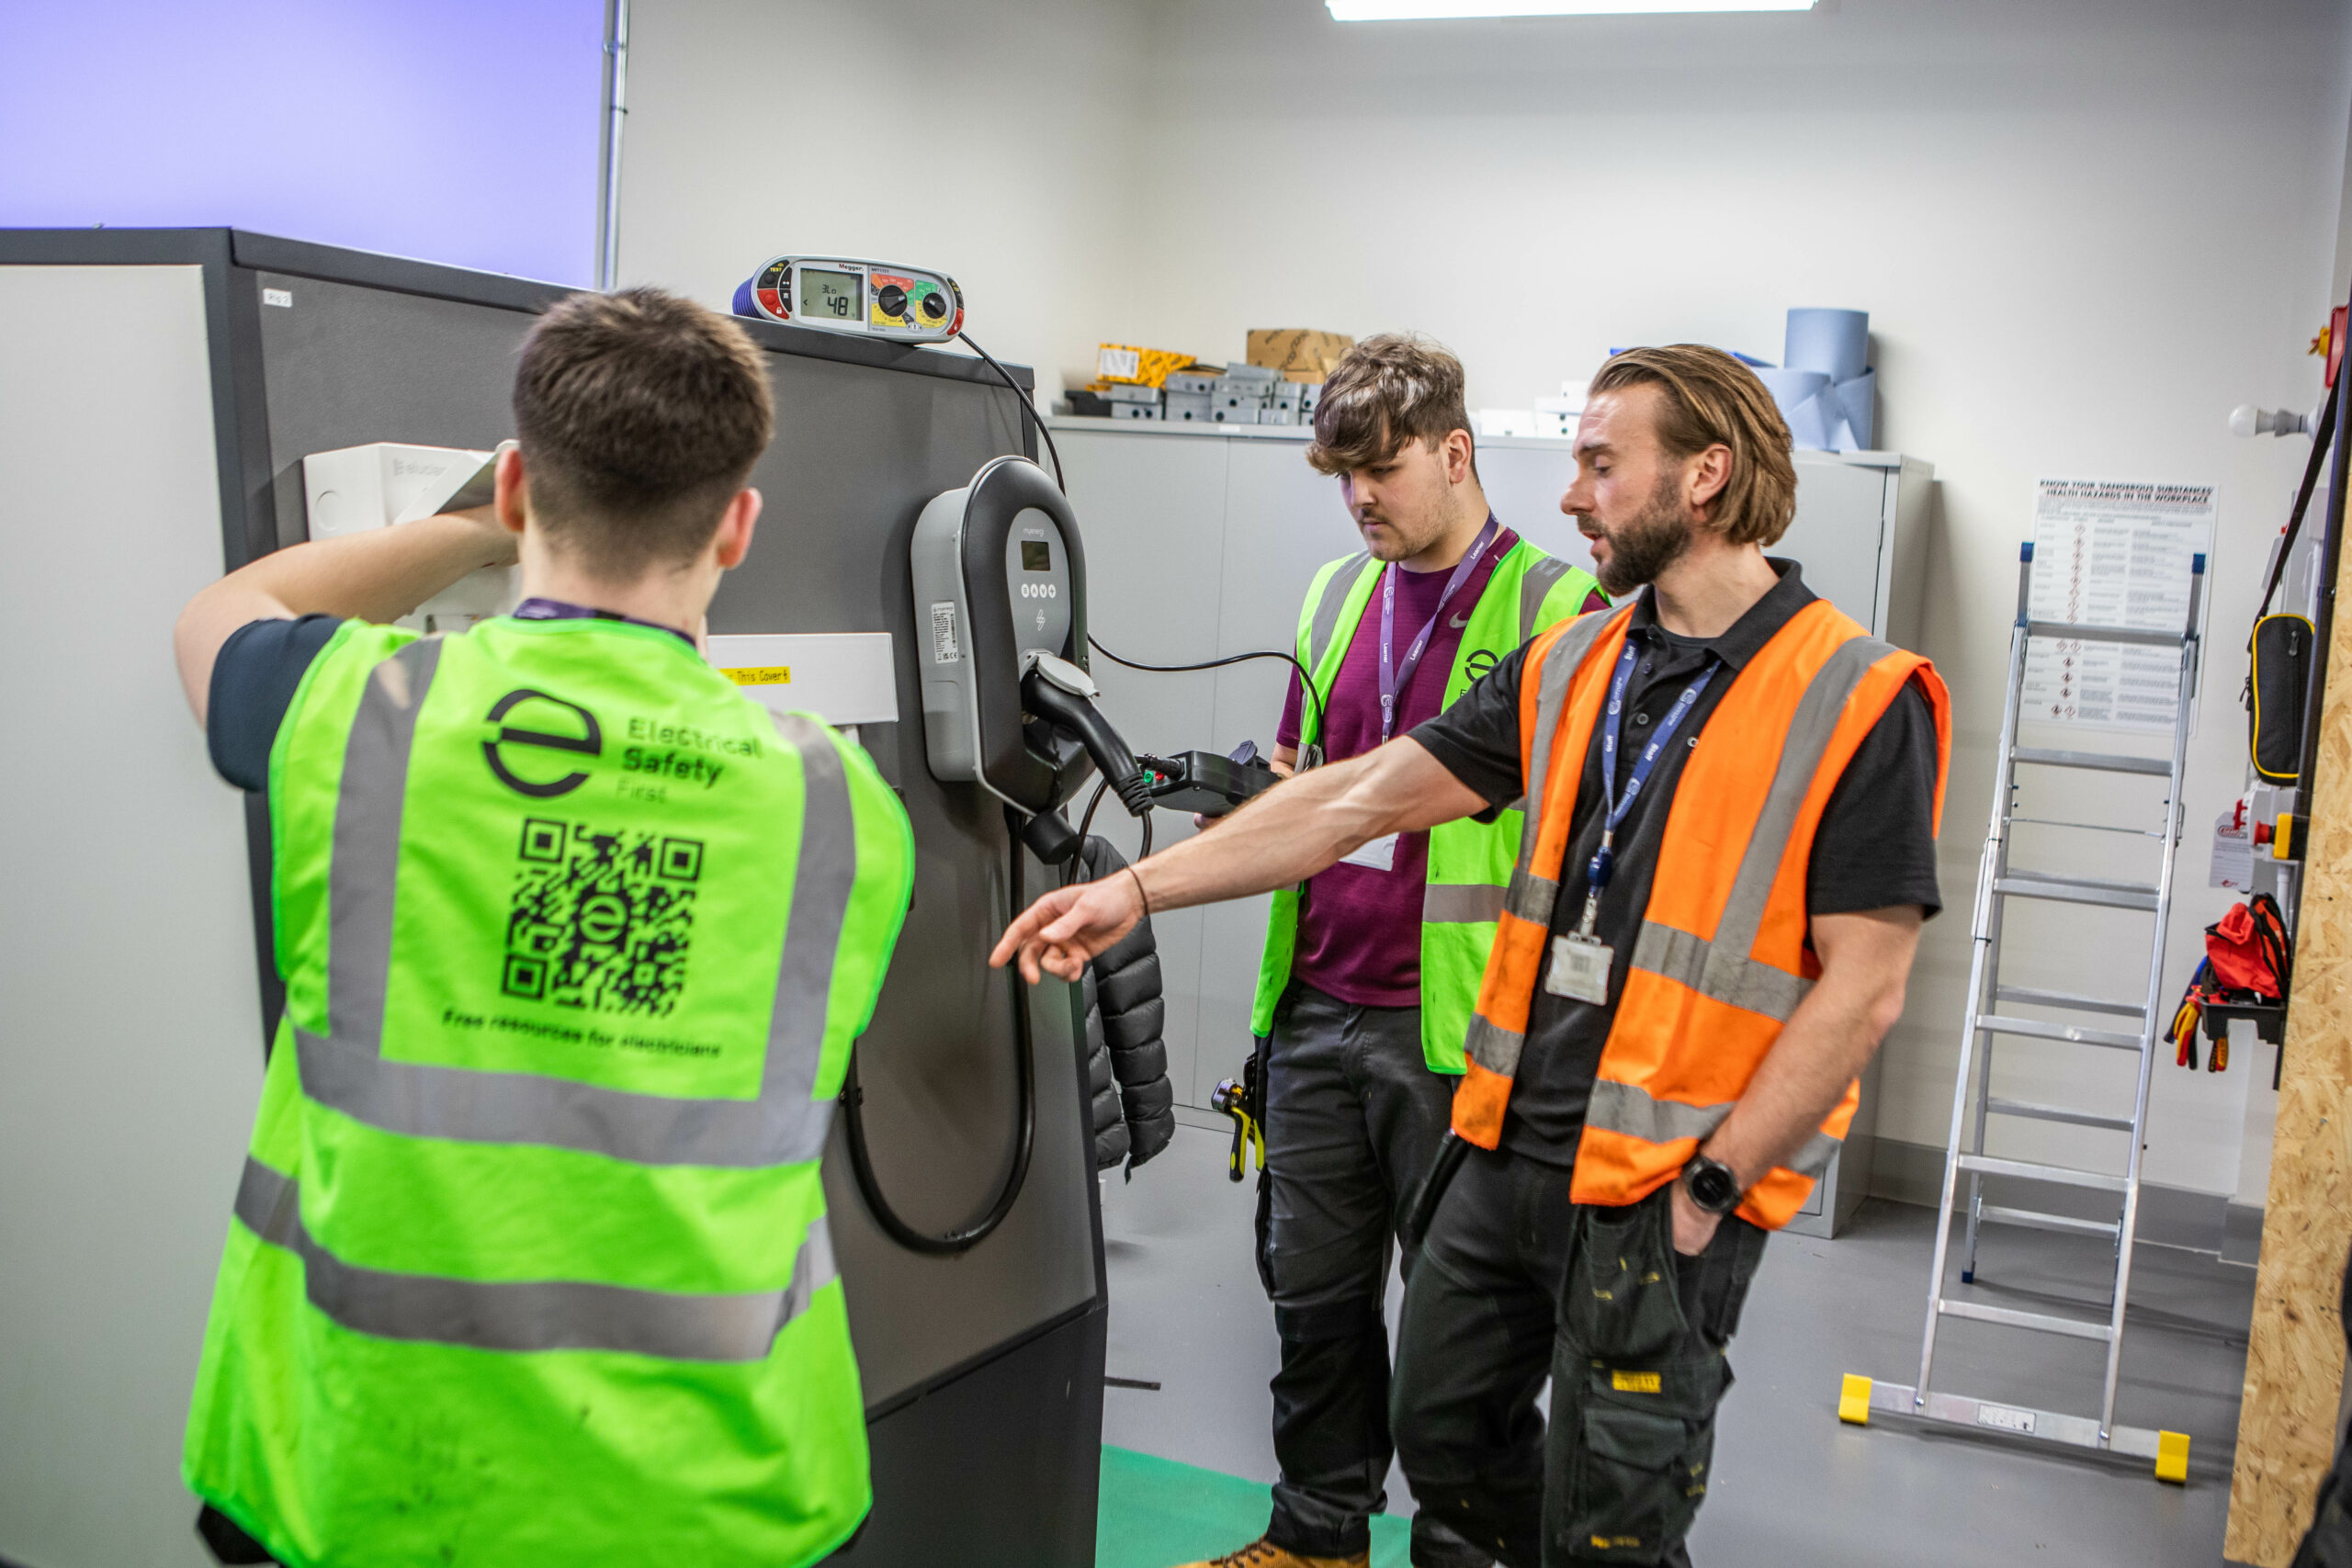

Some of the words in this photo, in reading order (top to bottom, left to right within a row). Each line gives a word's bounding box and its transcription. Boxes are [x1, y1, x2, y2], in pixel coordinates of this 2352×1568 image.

[827, 296, 849, 317] 48
[2040, 478, 2068, 489] KNOW
[2071, 479, 2096, 491] YOUR
[2045, 488, 2078, 499] HEALTH
[2080, 489, 2121, 501] HAZARDS
[2136, 492, 2152, 503] THE
[2154, 493, 2209, 505] WORKPLACE
[1470, 540, 1485, 560] Learner
[1409, 639, 1424, 661] Learner
[1623, 645, 1636, 661] Staff
[737, 671, 756, 682] This
[759, 670, 782, 682] Cover
[628, 716, 764, 759] Electrical
[1605, 735, 1613, 753] Staff
[1645, 742, 1659, 762] Staff
[623, 745, 724, 790] Safety
[616, 773, 669, 804] First
[442, 1009, 484, 1029] Free
[489, 1017, 582, 1043] resources
[588, 1028, 615, 1047] for
[619, 1034, 722, 1058] electricians
